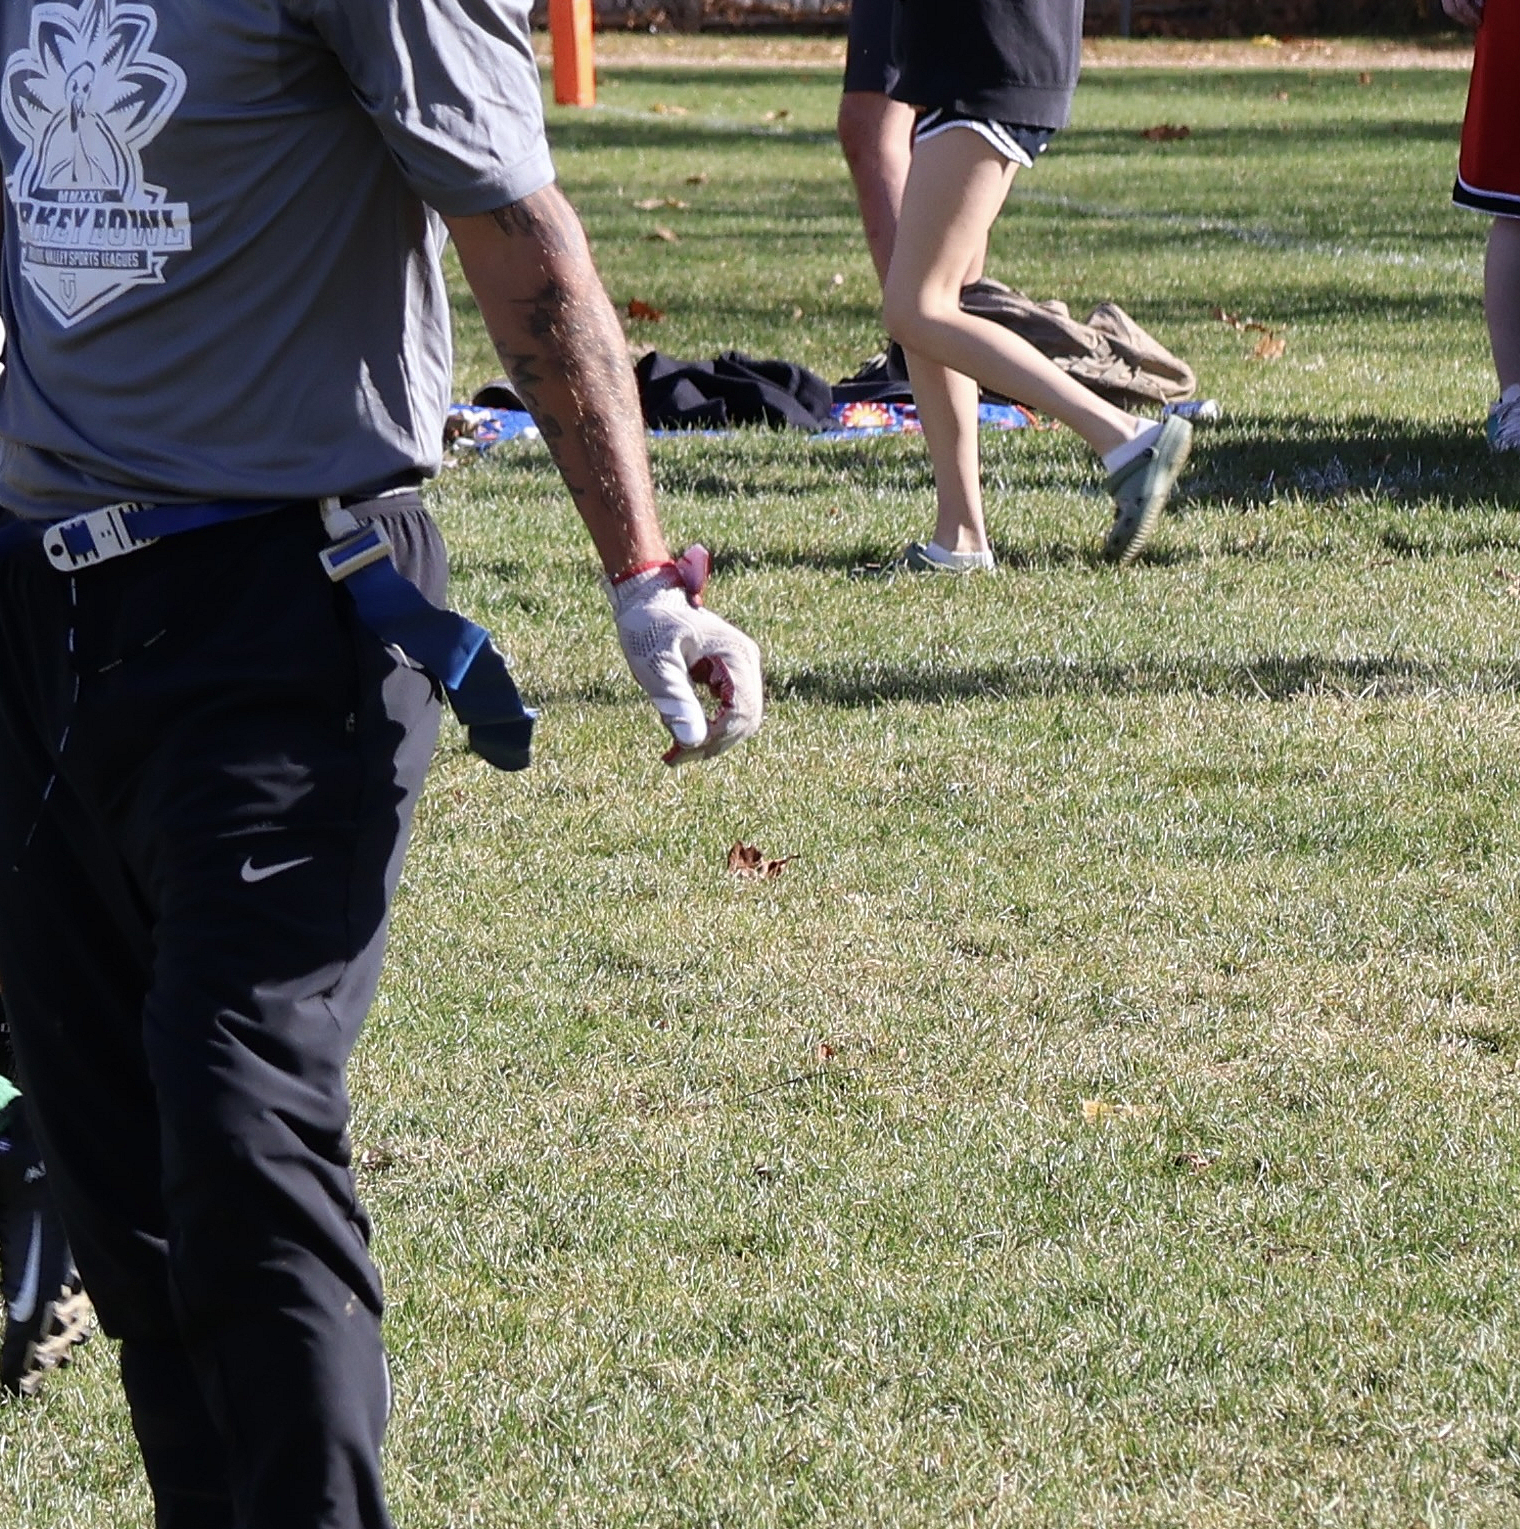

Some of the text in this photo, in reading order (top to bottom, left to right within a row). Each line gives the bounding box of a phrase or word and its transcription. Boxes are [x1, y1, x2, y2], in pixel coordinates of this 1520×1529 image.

[57, 190, 105, 203] MMXXV
[19, 202, 185, 246] RKEY BOWL
[69, 250, 99, 266] SPORTS
[102, 252, 139, 267] LEAGUES
